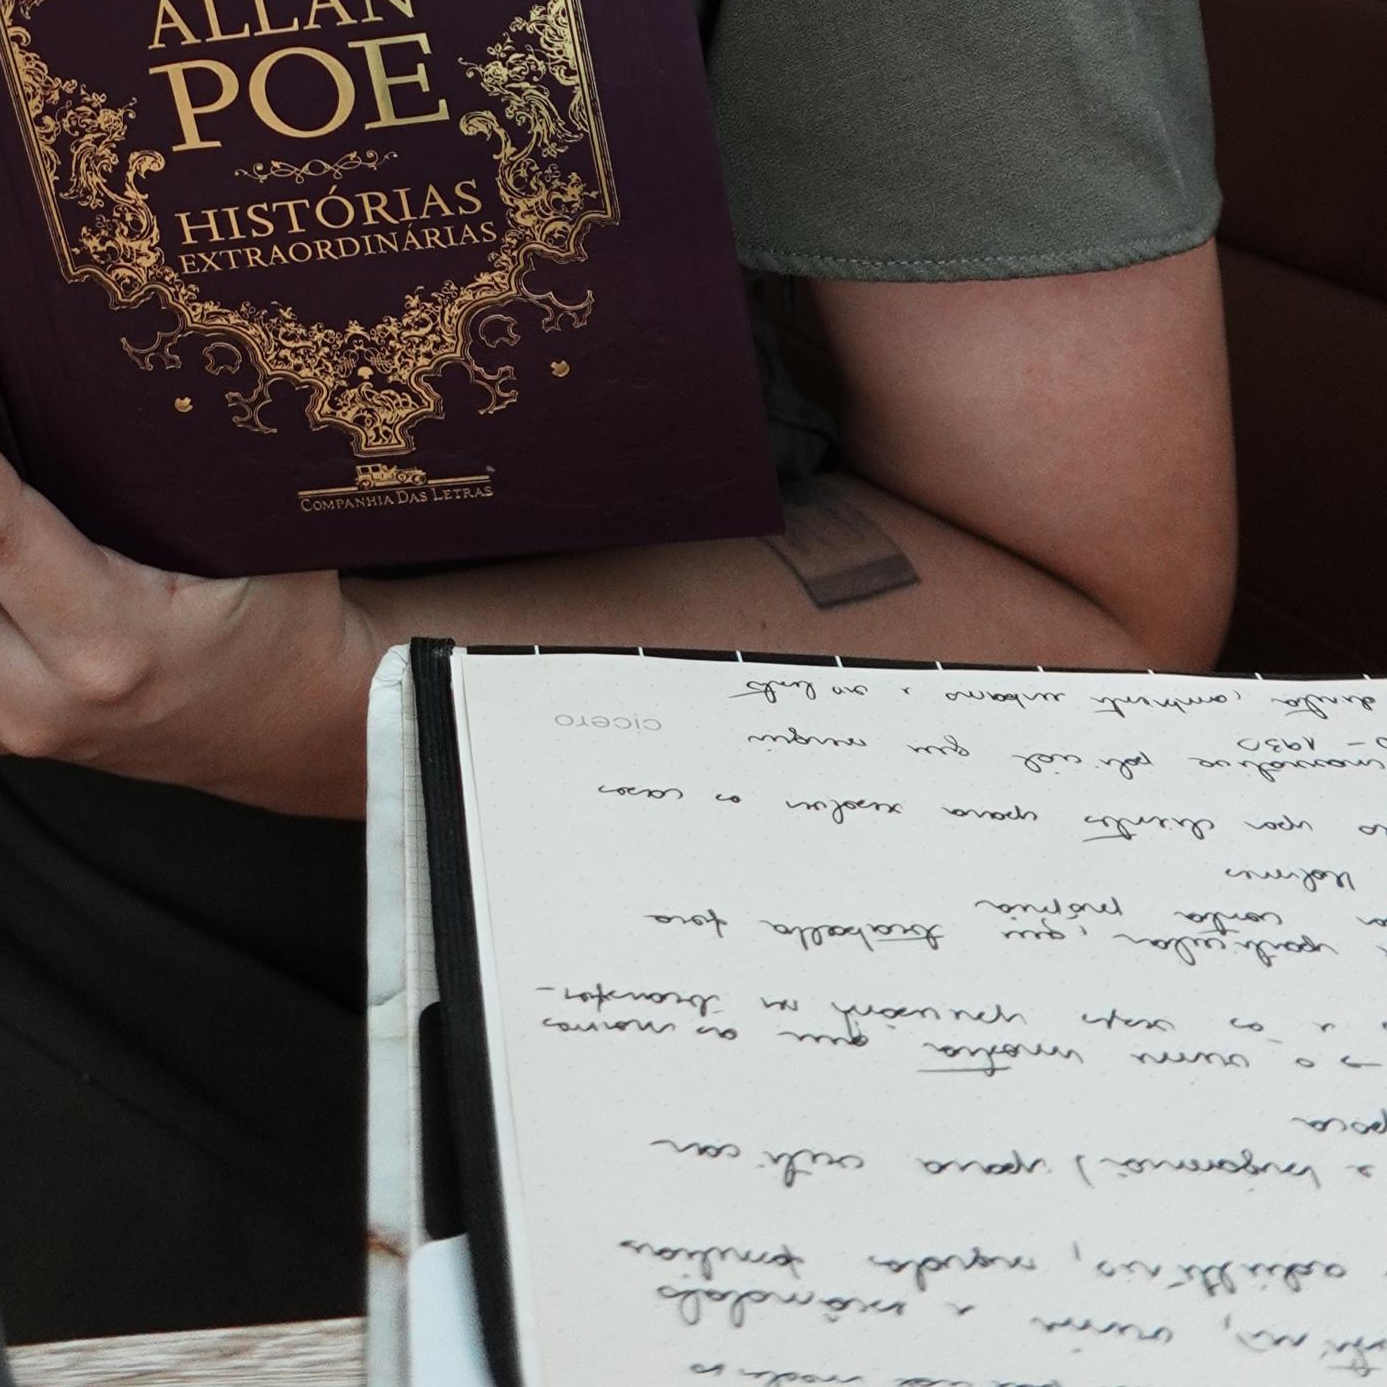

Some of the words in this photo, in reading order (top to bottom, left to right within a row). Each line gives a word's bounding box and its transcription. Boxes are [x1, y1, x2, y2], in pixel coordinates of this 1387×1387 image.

[148, 32, 450, 153] POE
[176, 177, 485, 249] HISTÓRIAS
[177, 219, 498, 275] EXTRAORDINÁRIAS
[299, 487, 393, 514] COMPANHIA
[430, 481, 495, 506] LETRAS
[553, 713, 663, 735] cicero
